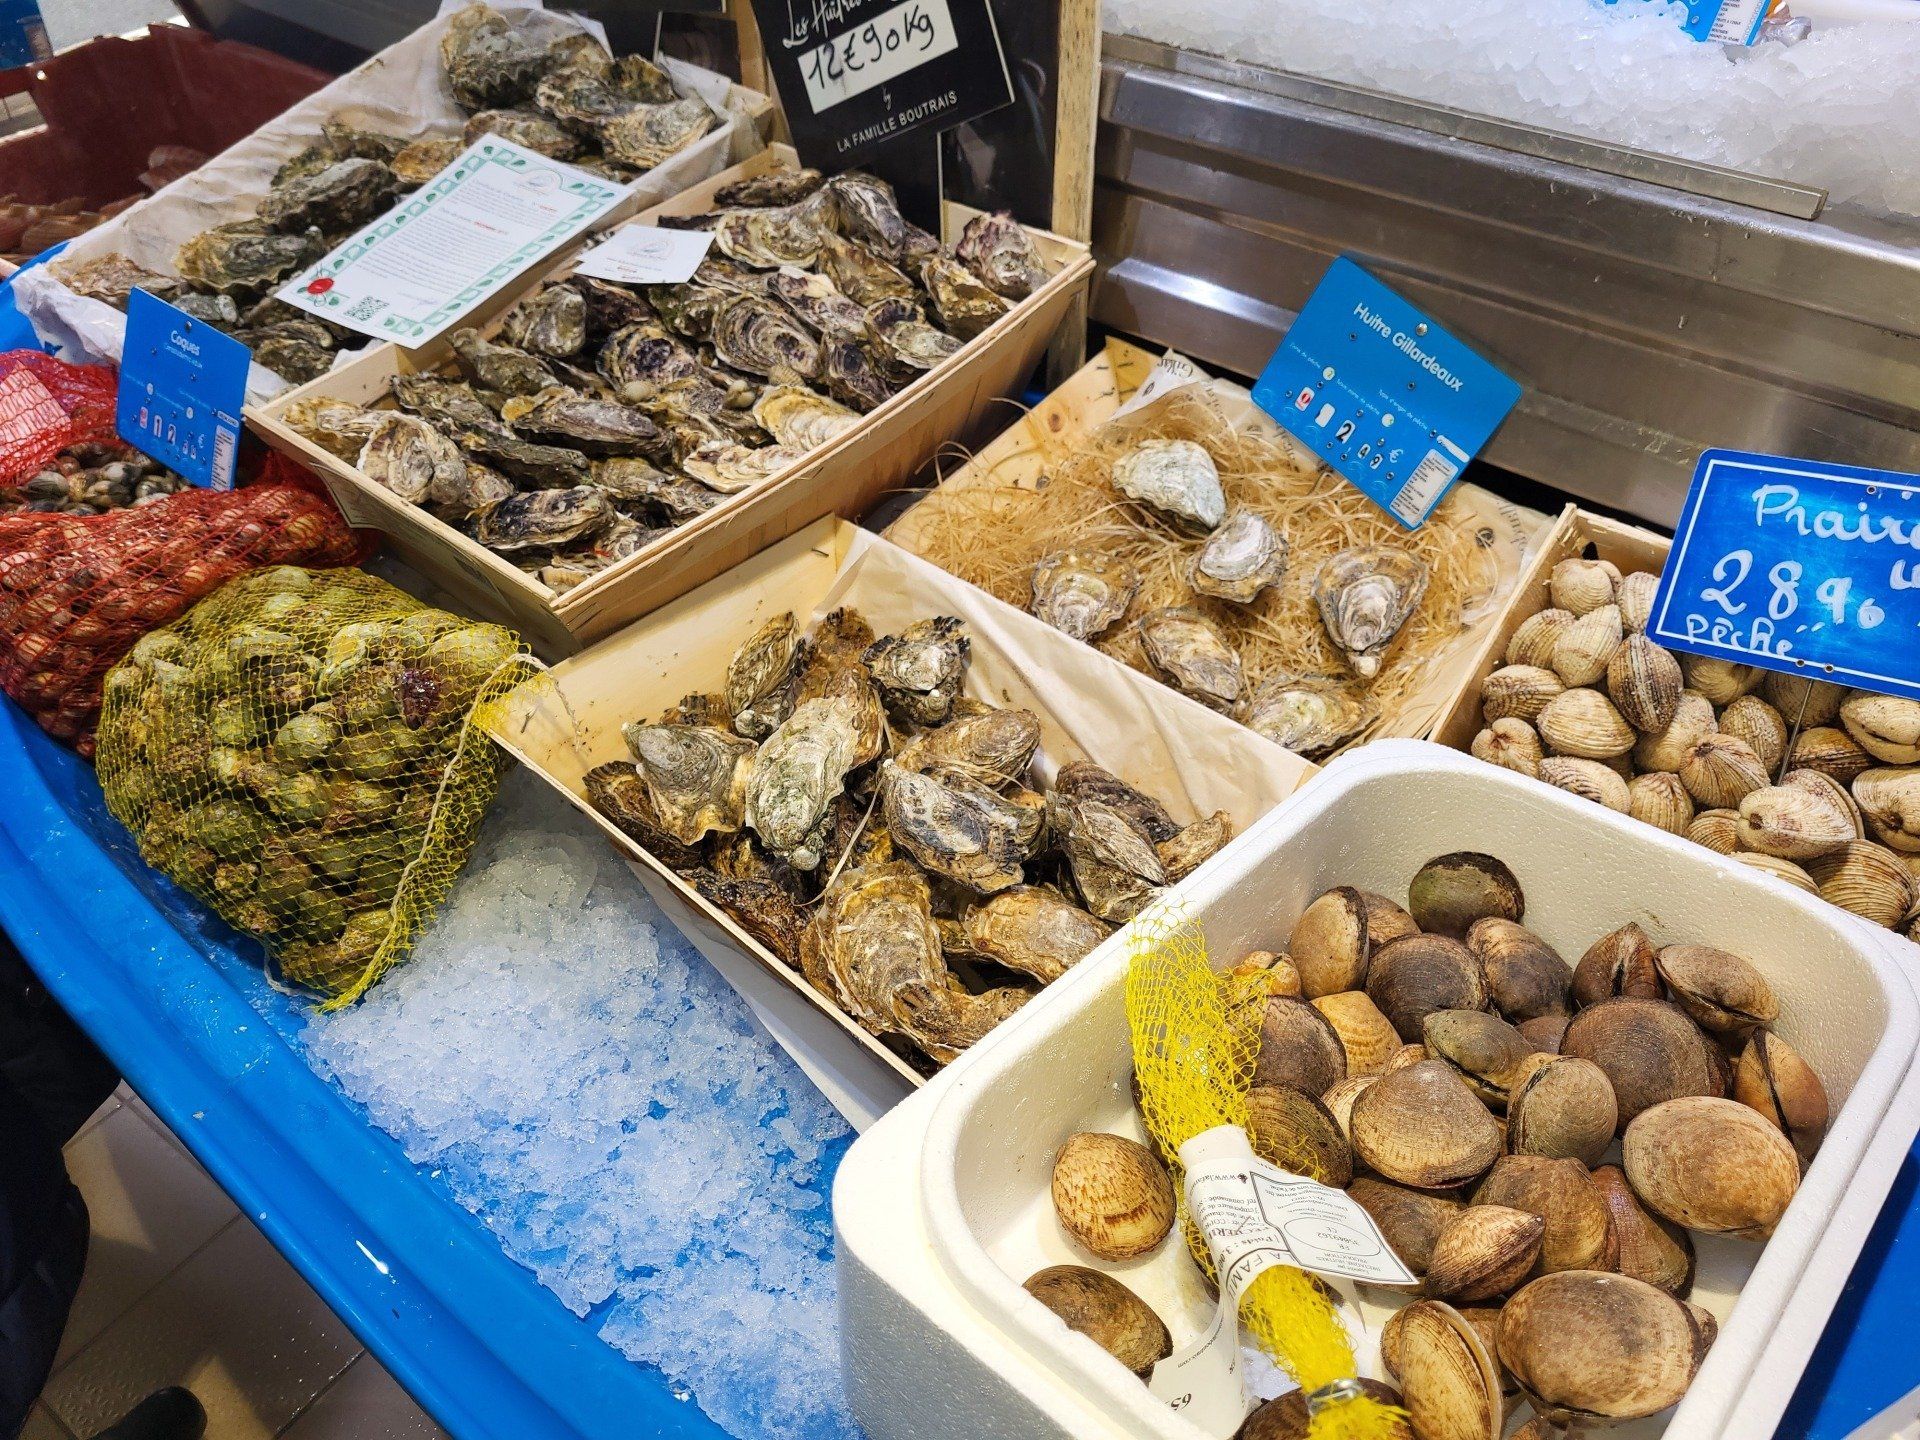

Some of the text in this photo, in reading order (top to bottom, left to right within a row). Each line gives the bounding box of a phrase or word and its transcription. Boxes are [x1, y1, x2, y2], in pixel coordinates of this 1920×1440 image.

[837, 90, 958, 153] LA FAMILLE BOUTRAIS
[170, 330, 200, 357] Coques
[1391, 332, 1465, 393] Gillardeaux
